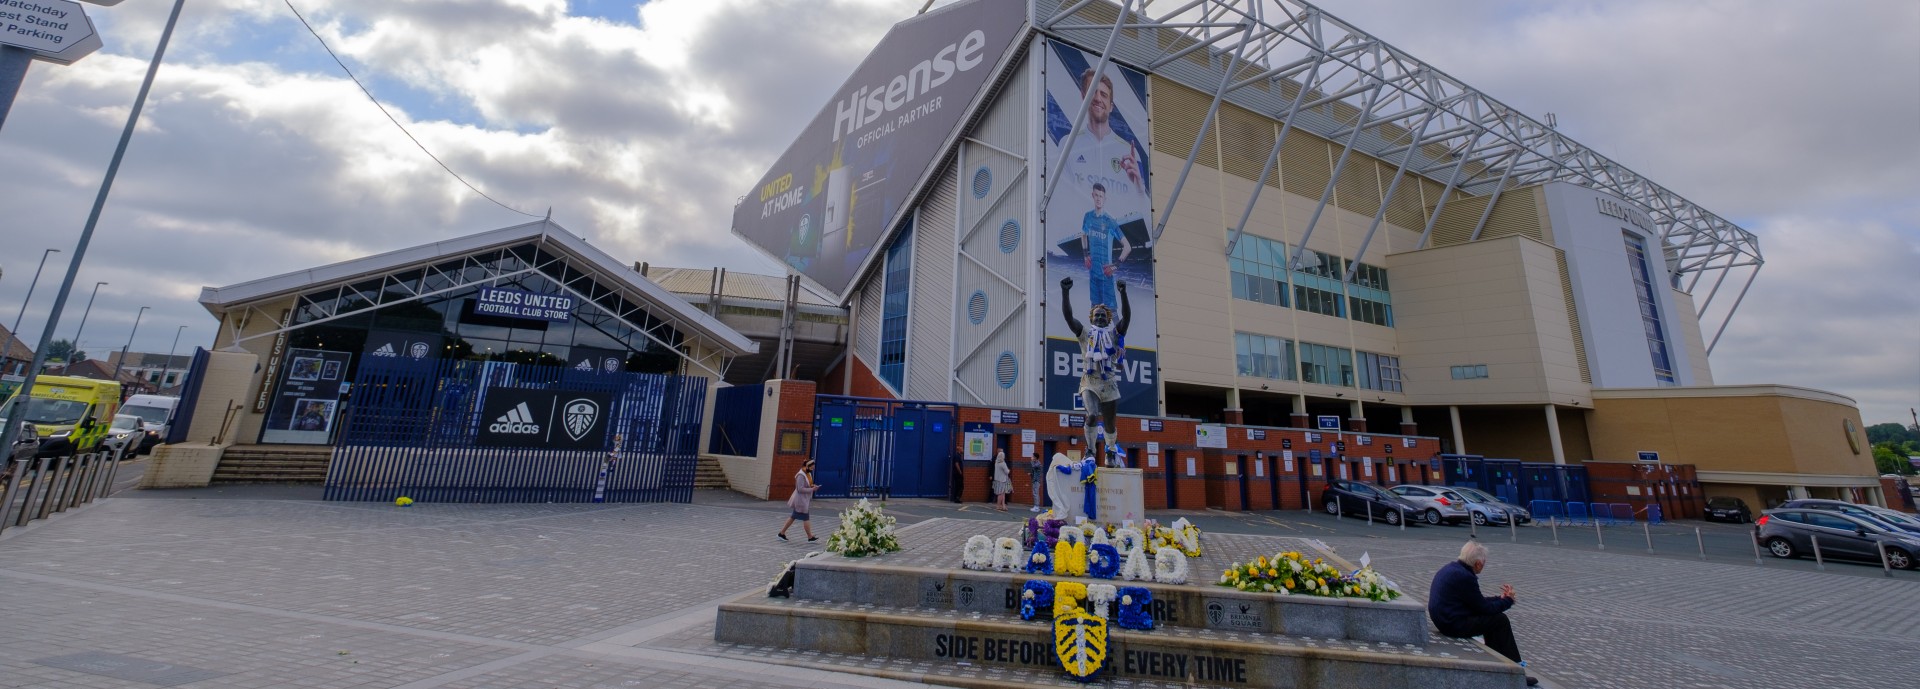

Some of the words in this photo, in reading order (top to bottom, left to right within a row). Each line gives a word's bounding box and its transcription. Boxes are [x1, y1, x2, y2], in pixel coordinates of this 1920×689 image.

[0, 11, 21, 21] est
[25, 15, 69, 30] Stand
[7, 24, 63, 43] Parking
[832, 29, 985, 142] Hisense
[857, 120, 896, 149] OFFICIAL
[898, 96, 942, 129] PARTNER
[760, 173, 793, 202] UNITED
[761, 199, 774, 220] AT
[774, 186, 804, 214] HOME
[478, 303, 519, 315] FOOTBALL
[521, 307, 542, 317] CLUB
[543, 309, 569, 320] STORE
[480, 289, 522, 305] LEEDS
[524, 294, 571, 310] UNITED
[257, 356, 278, 410] UNITED
[1053, 351, 1153, 385] BEVE
[489, 421, 540, 434] adidas
[962, 534, 1188, 585] GRANDAD
[1020, 579, 1154, 630] PETE
[936, 633, 978, 660] SIDE
[983, 637, 1057, 666] BEFORE
[1124, 649, 1188, 678] EVERY
[1193, 655, 1247, 683] TIME
